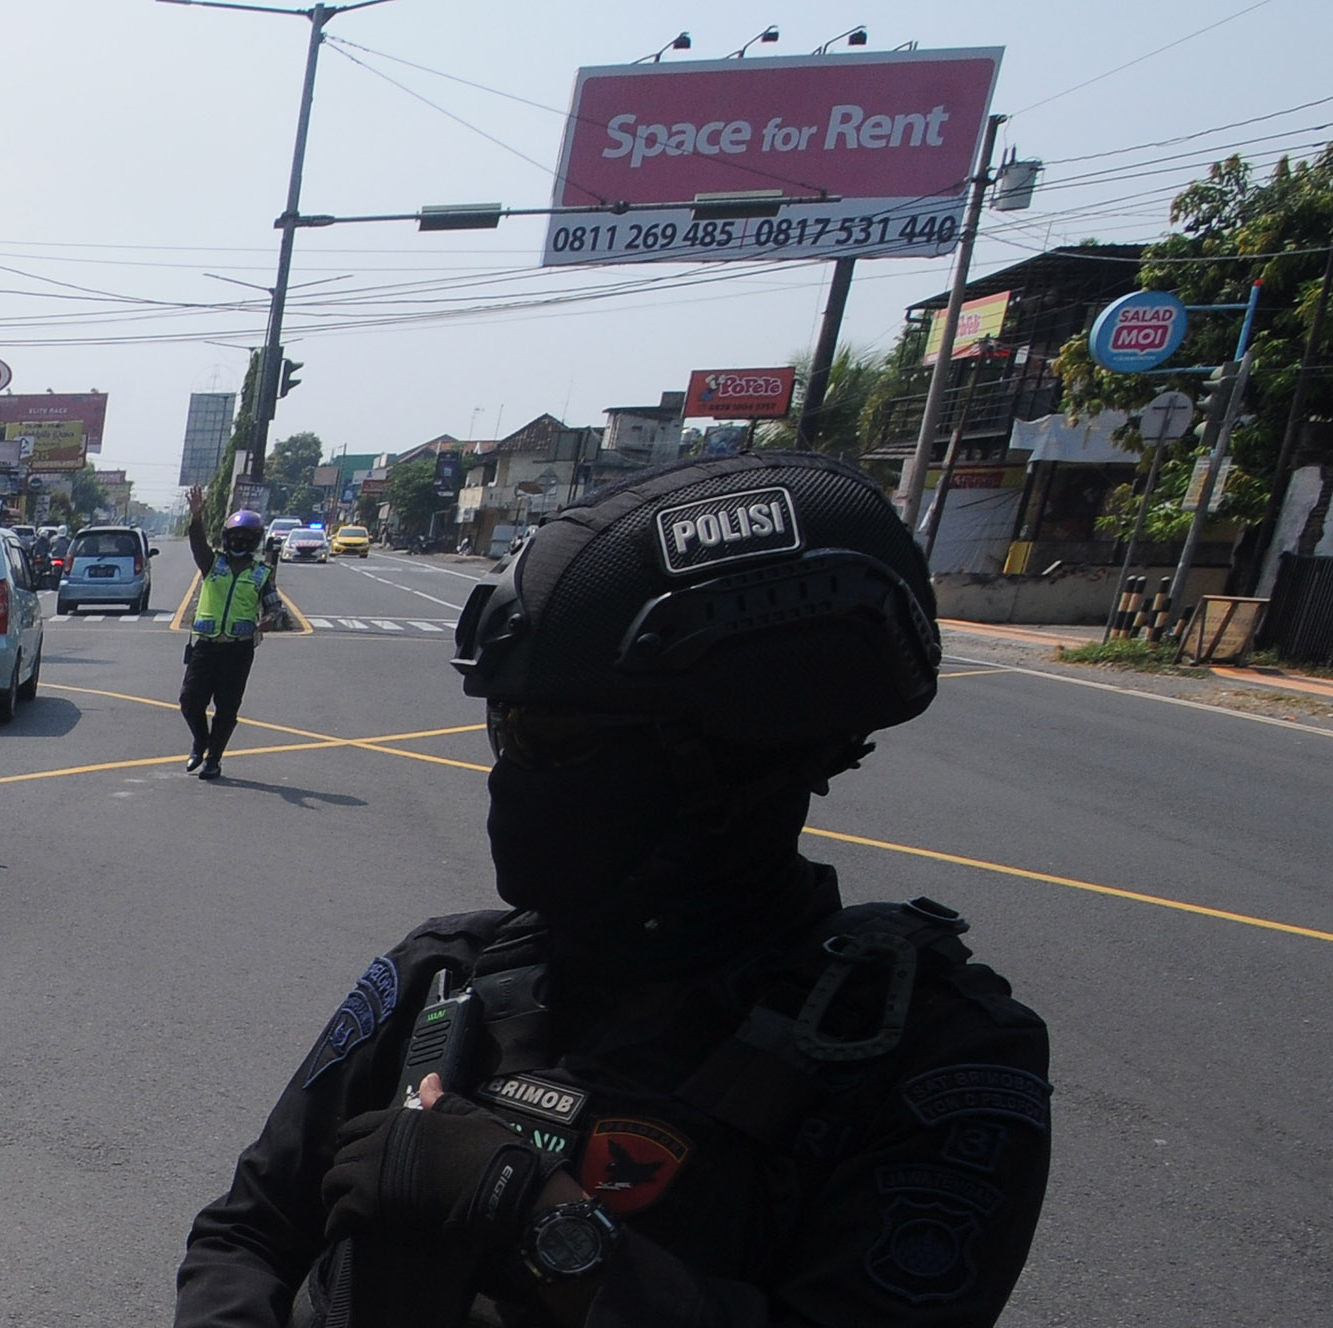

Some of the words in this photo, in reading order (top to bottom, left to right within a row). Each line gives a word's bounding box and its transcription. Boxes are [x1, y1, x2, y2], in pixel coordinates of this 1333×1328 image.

[602, 113, 751, 168] Space
[762, 117, 817, 151] for
[823, 104, 949, 150] Rent
[553, 225, 616, 252] 0811
[625, 222, 677, 250] 269
[681, 220, 735, 247] 485
[754, 219, 831, 247] 0817
[834, 217, 888, 244] 531
[892, 214, 957, 244] 440
[1119, 309, 1174, 322] SALAD
[1117, 328, 1163, 345] MOI
[672, 501, 785, 555] POLISI
[489, 1077, 575, 1114] BRIMOB
